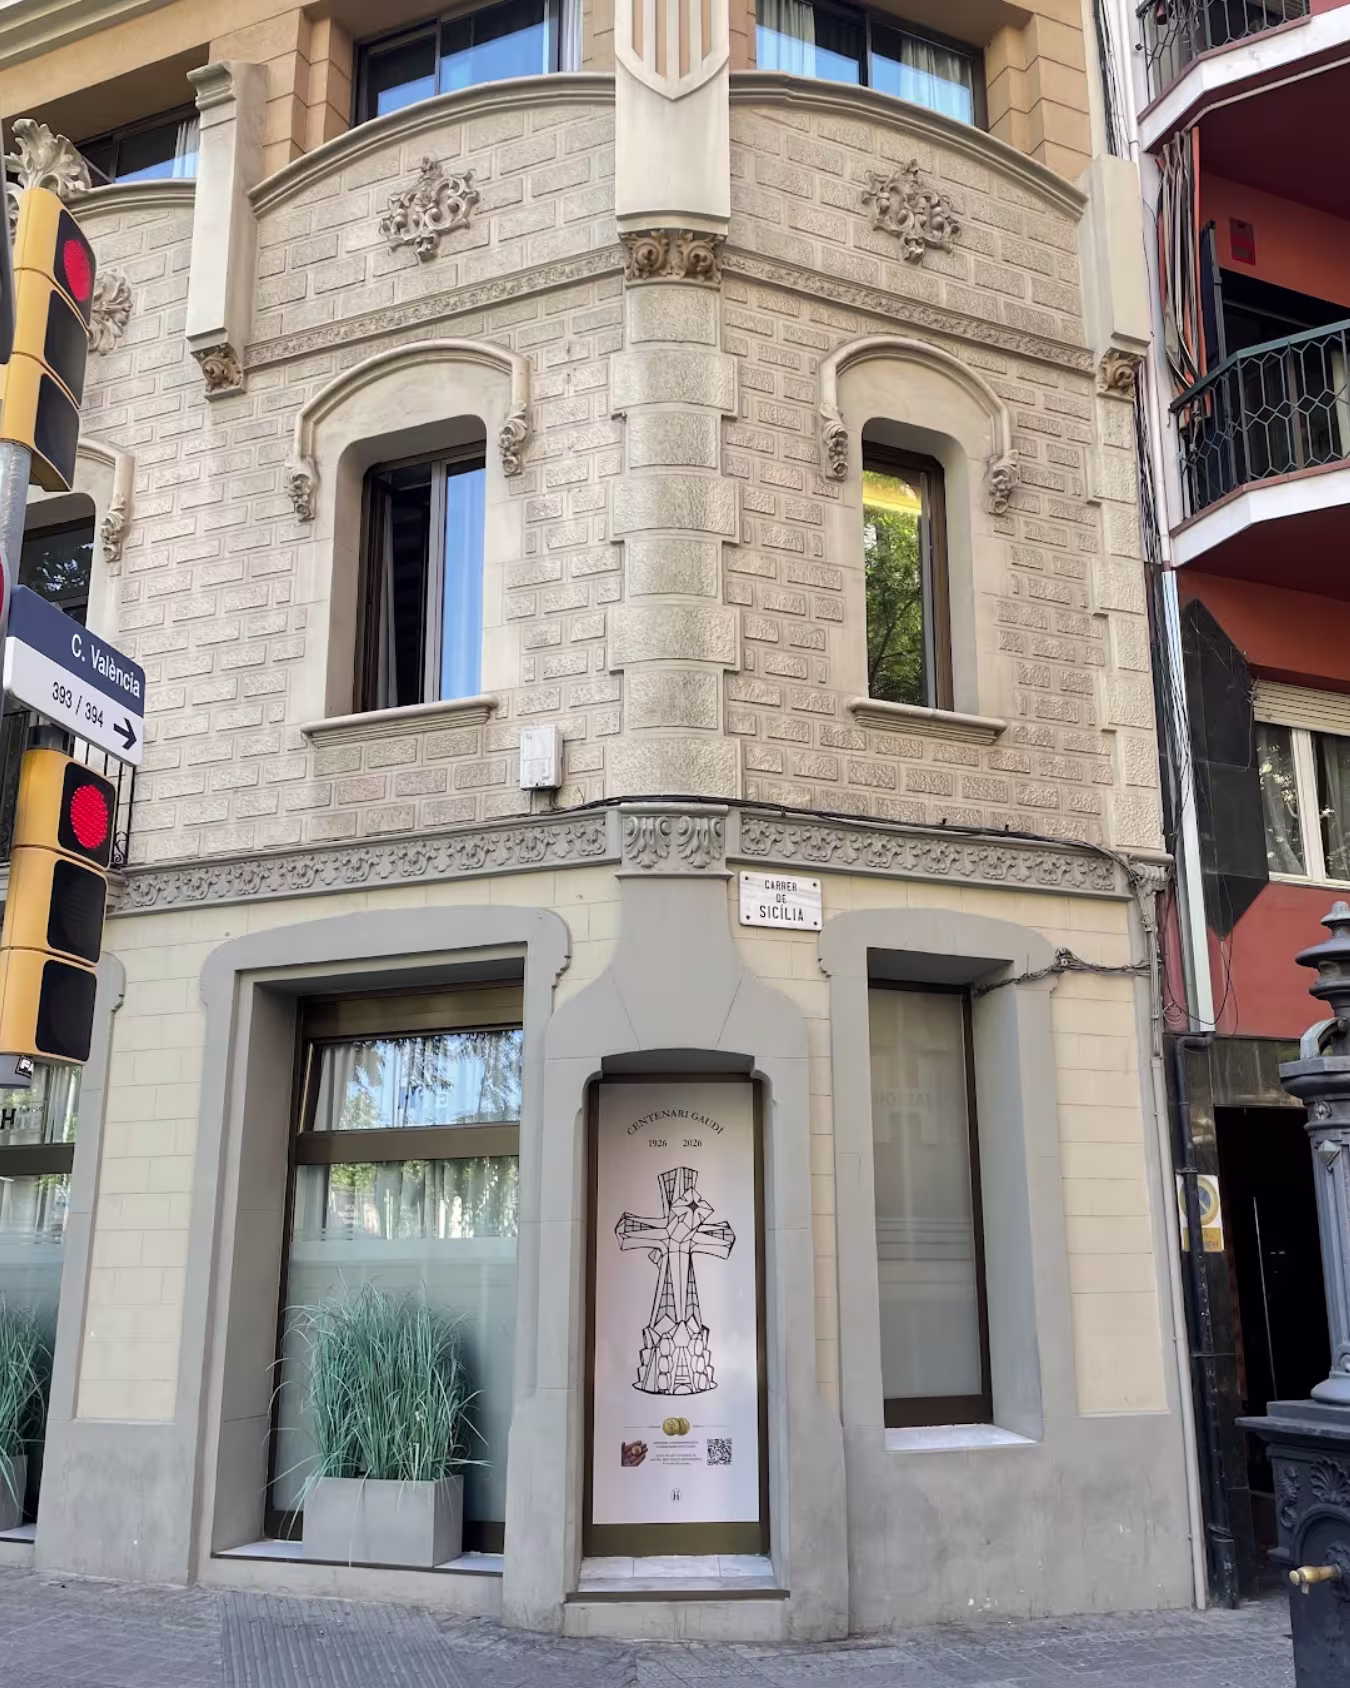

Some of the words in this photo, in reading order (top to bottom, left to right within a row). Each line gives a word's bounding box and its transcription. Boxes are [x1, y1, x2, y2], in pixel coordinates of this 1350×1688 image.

[71, 633, 86, 662] C.
[91, 644, 141, 698] València
[52, 681, 73, 709] 393
[84, 701, 104, 728] 394
[764, 880, 797, 892] CARRER
[776, 893, 788, 904] DE
[759, 904, 804, 921] SICÍLIA
[627, 1109, 689, 1136] CENTENARI
[648, 1139, 668, 1148] 1926
[682, 1139, 703, 1148] 2026
